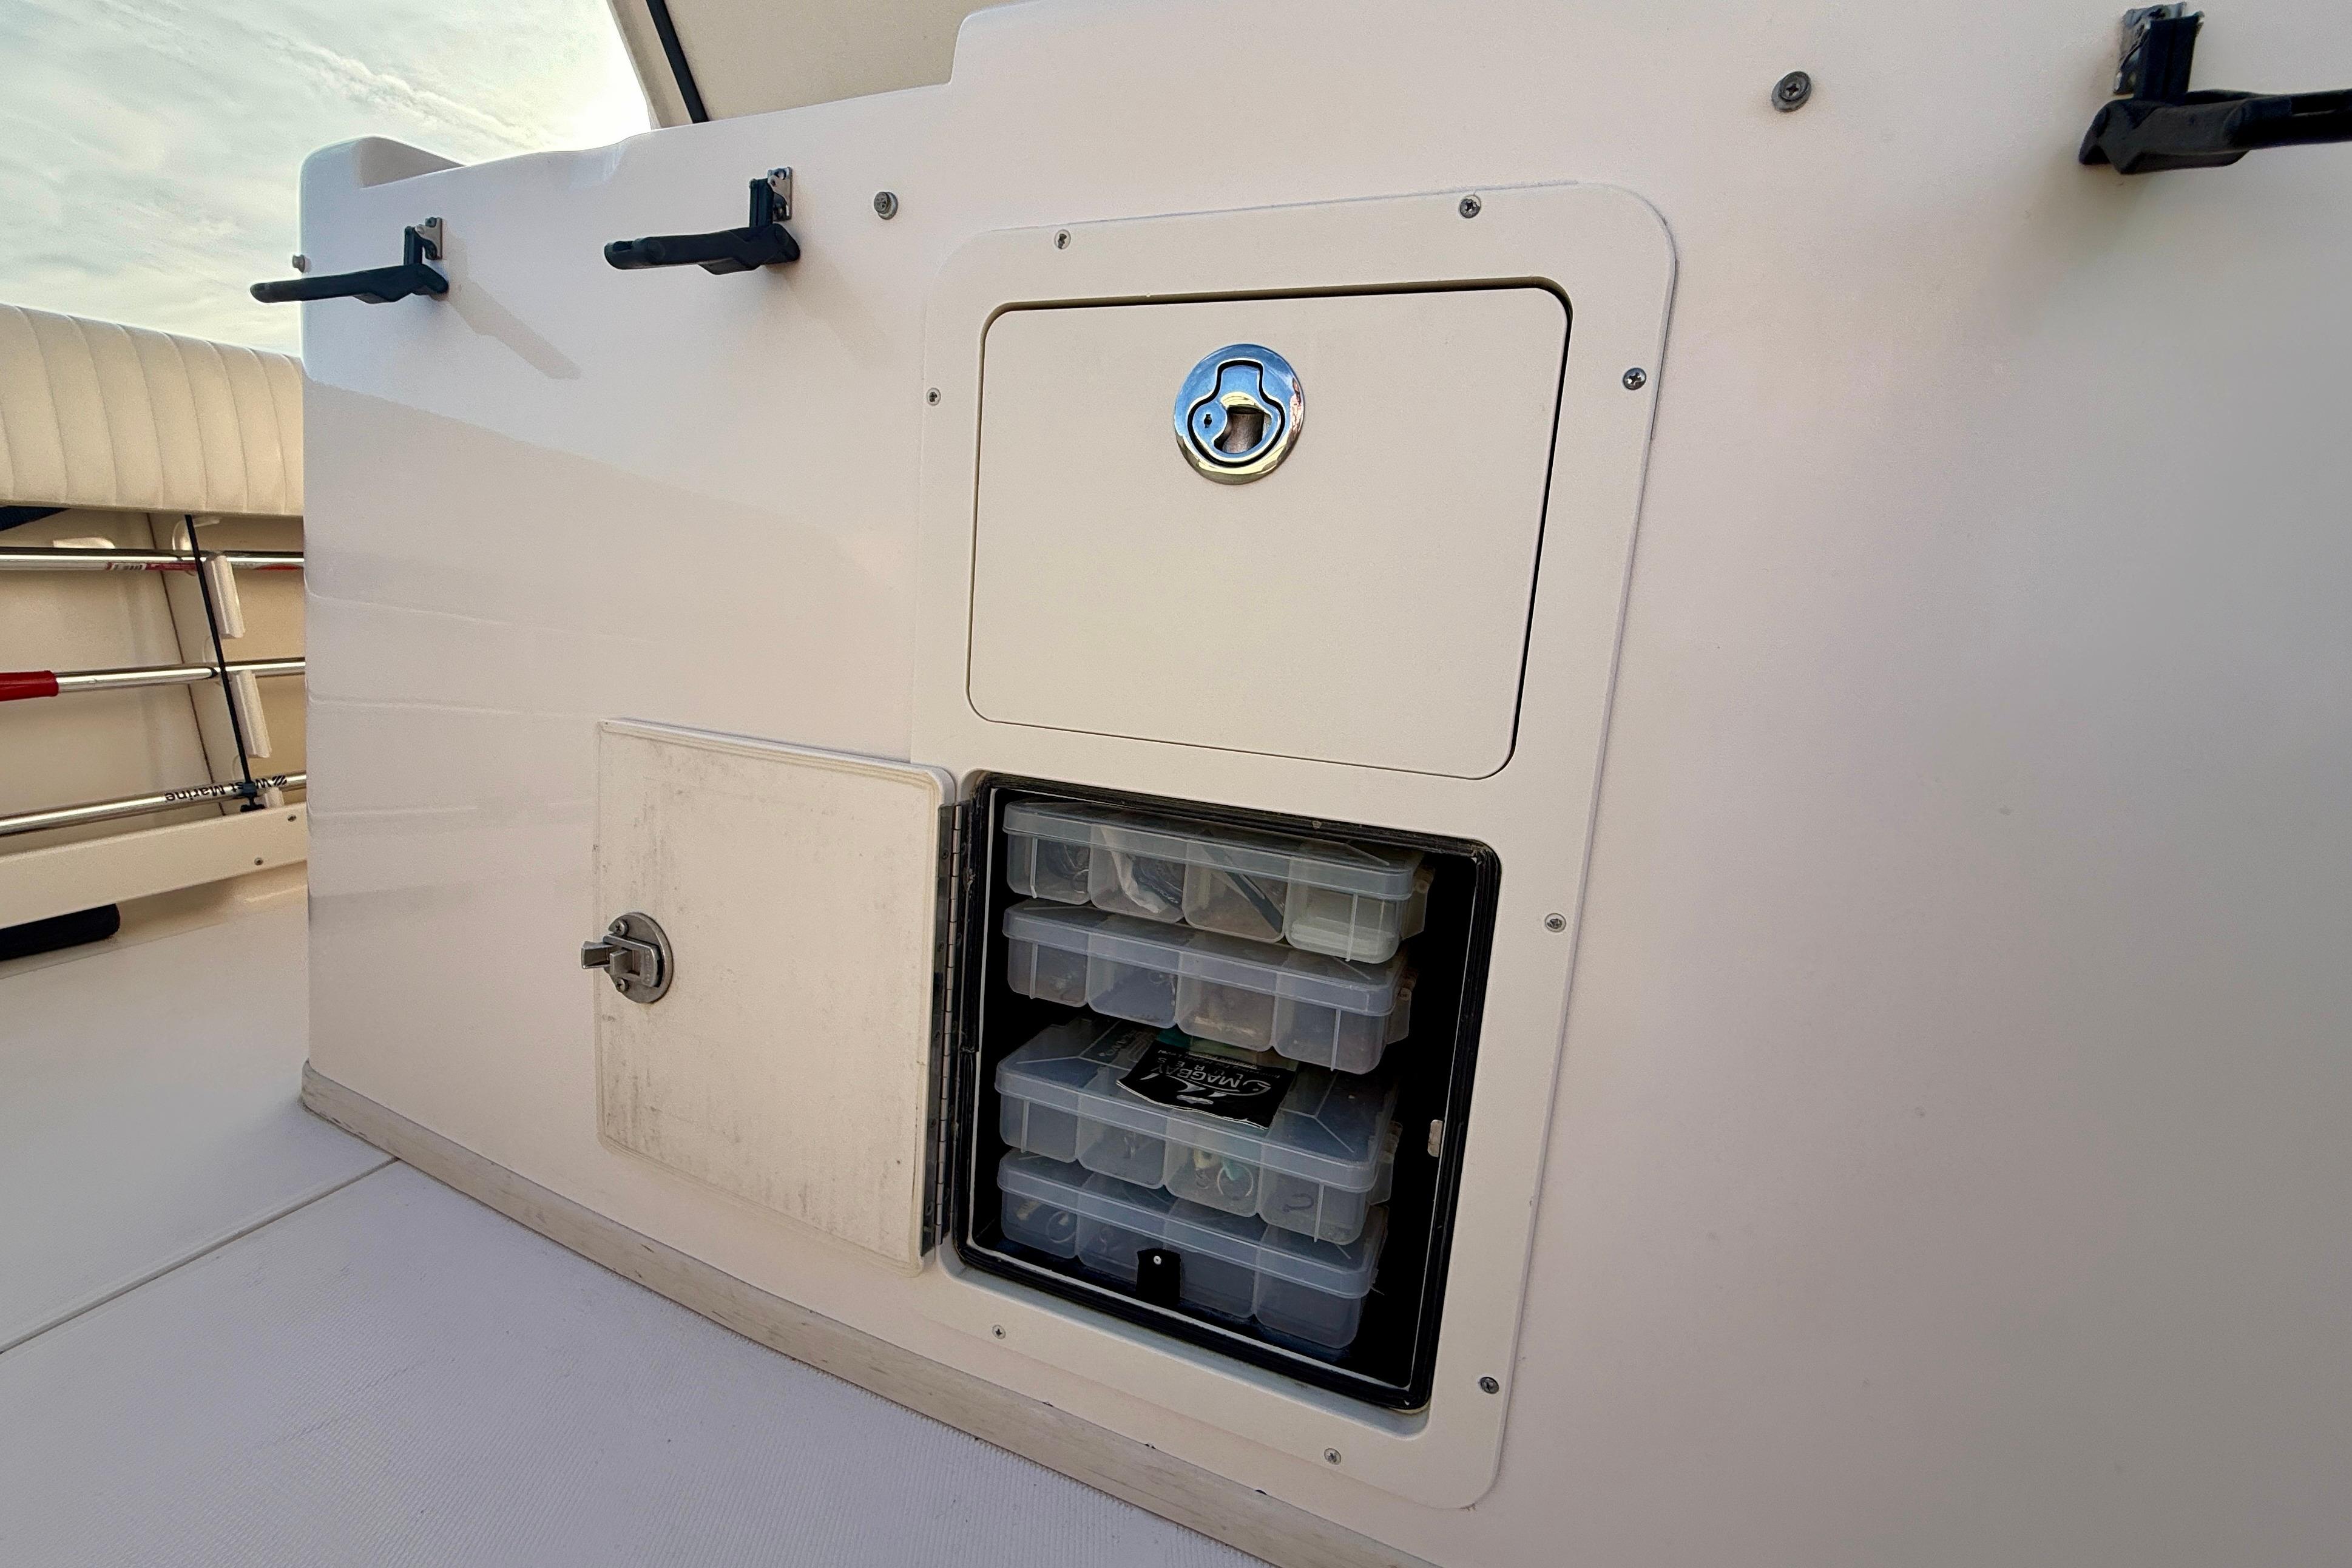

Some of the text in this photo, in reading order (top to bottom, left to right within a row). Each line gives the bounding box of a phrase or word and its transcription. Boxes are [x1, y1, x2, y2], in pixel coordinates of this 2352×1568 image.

[164, 778, 272, 802] Wst Marine
[1151, 1064, 1241, 1088] MAGBAY
[1157, 1057, 1243, 1080] LURES
